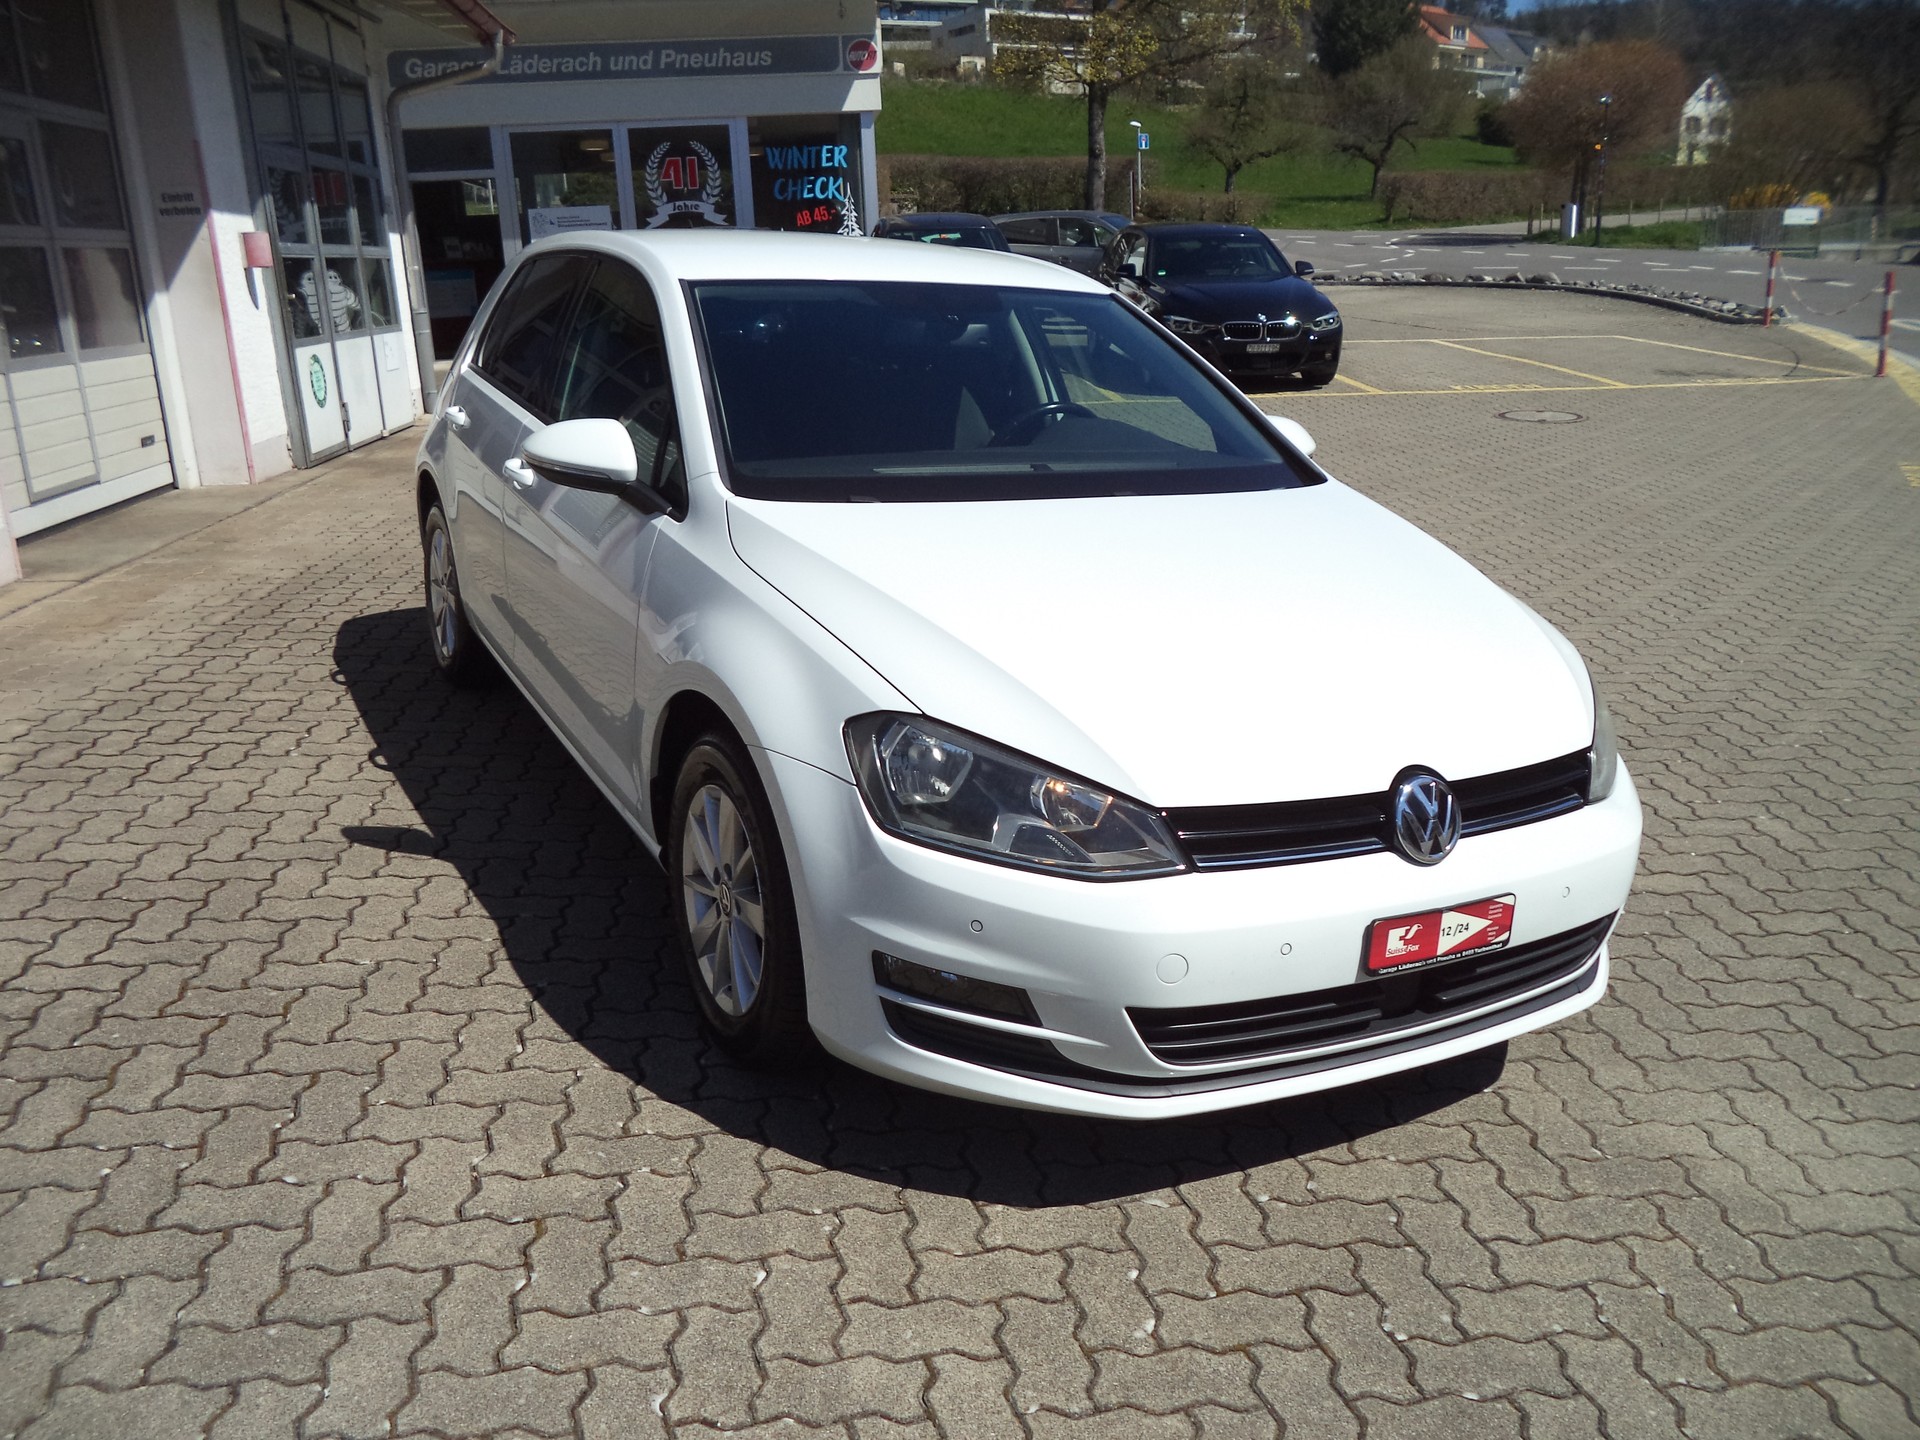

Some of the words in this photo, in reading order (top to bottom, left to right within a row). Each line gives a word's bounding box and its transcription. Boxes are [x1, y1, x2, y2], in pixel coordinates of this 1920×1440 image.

[496, 53, 601, 75] Läderach
[609, 50, 653, 71] und
[660, 47, 772, 69] Pneuhaus
[765, 144, 848, 169] WINTER
[660, 156, 700, 190] 41
[773, 175, 846, 203] CHECK
[672, 202, 700, 212] Jahre
[796, 210, 812, 227] AB
